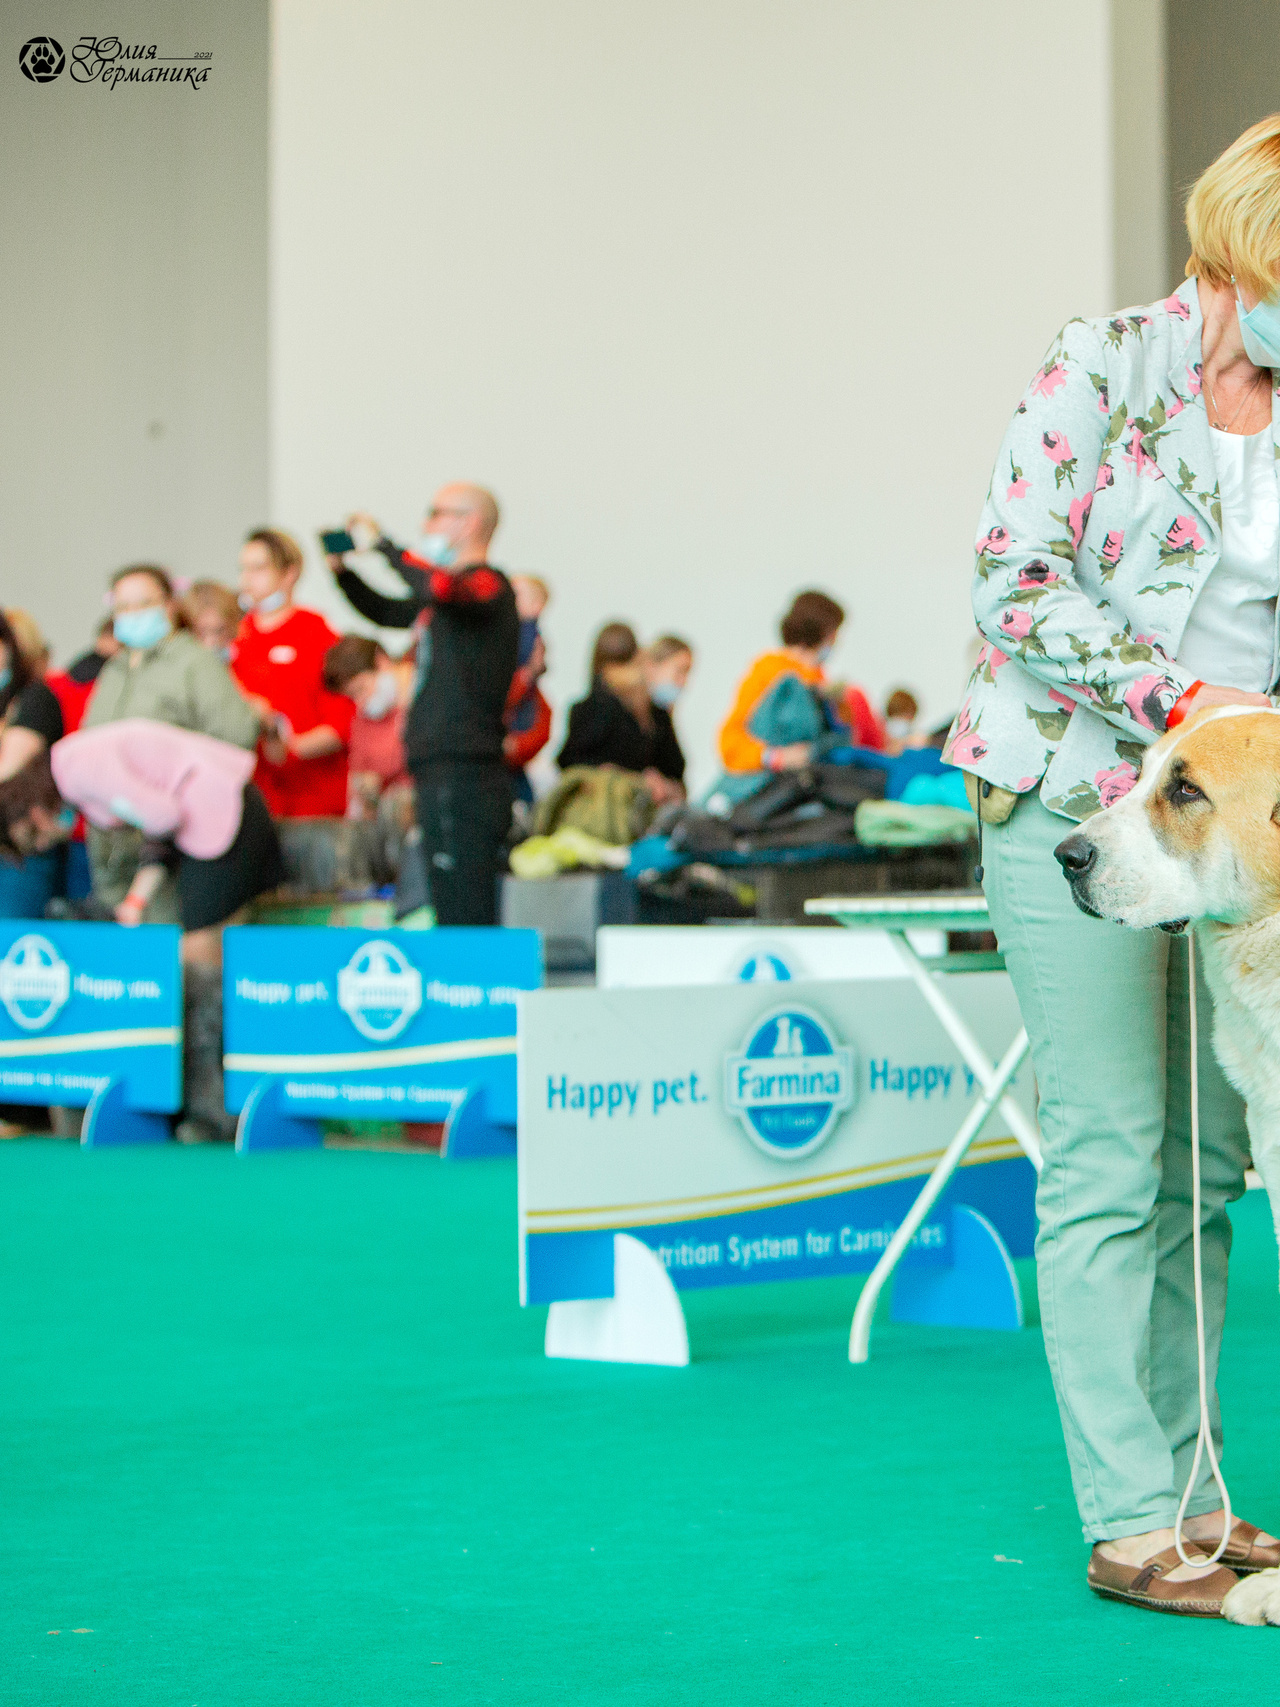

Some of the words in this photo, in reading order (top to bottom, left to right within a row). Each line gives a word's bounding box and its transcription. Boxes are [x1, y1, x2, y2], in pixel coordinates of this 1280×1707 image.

[547, 1073, 640, 1120] Happy
[653, 1069, 708, 1117] pet.
[738, 1062, 840, 1099] Farmina
[870, 1058, 953, 1101] Happy
[658, 1239, 721, 1269] trition
[728, 1234, 799, 1268] System
[806, 1228, 833, 1256] for
